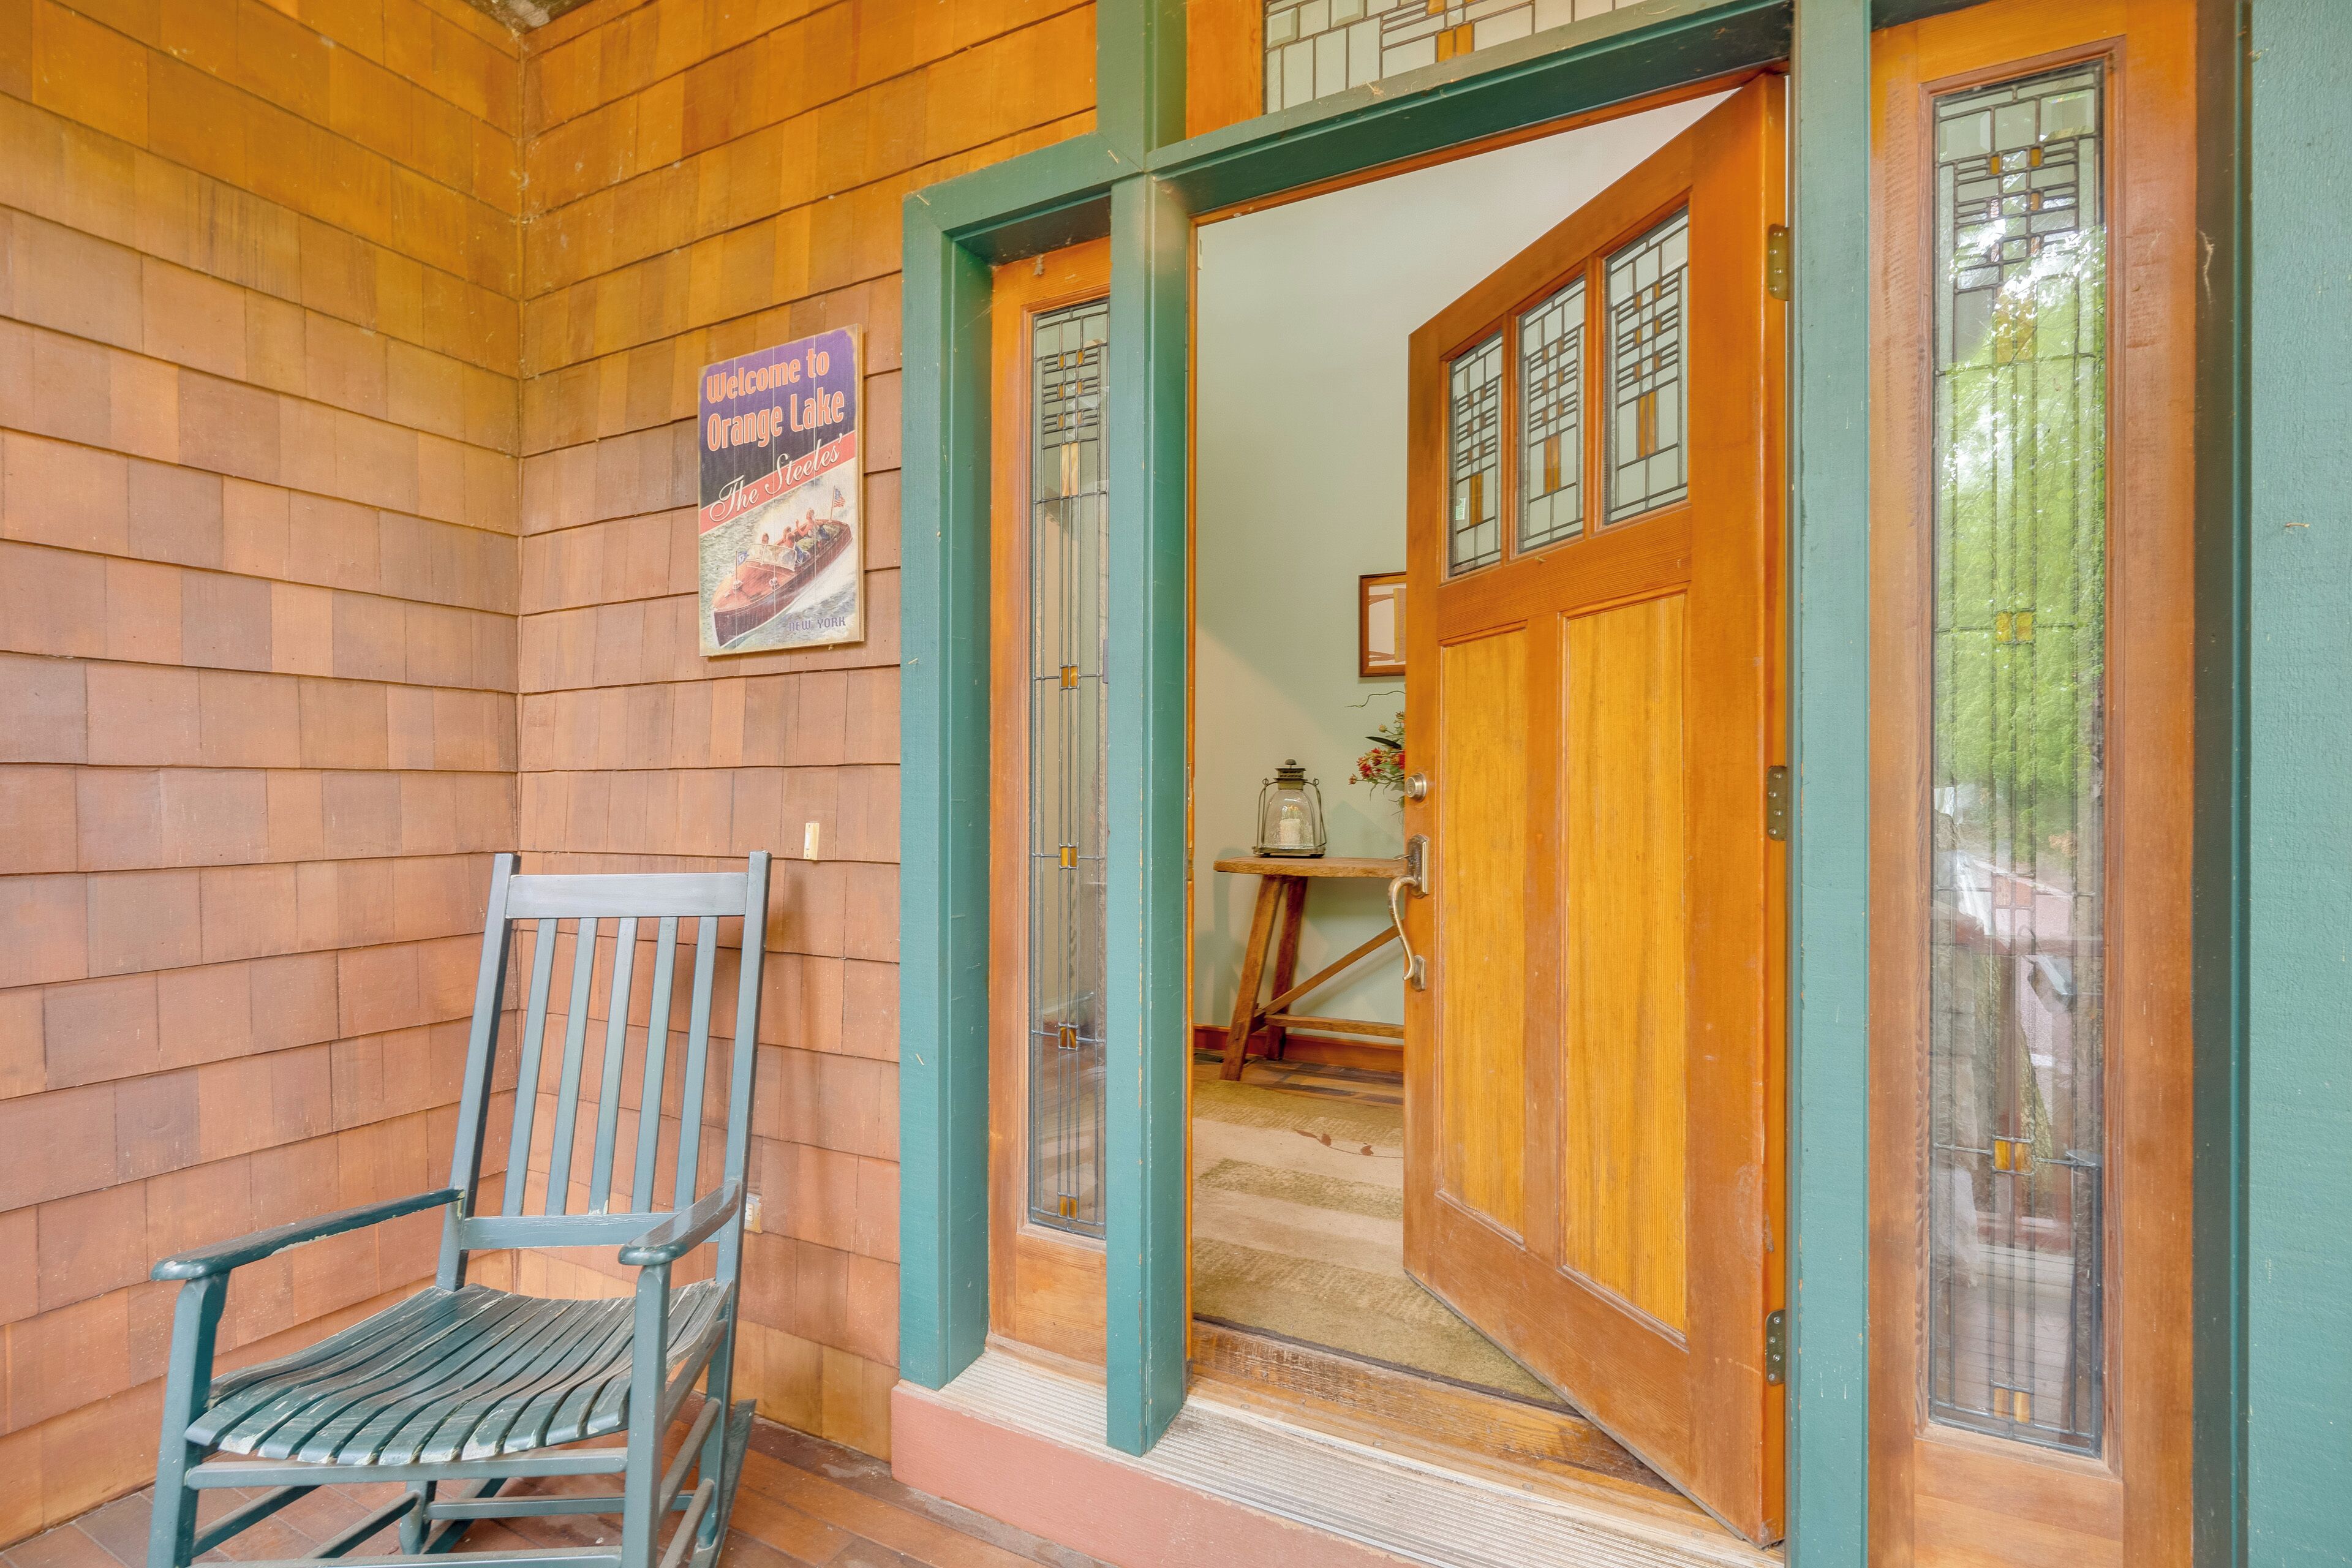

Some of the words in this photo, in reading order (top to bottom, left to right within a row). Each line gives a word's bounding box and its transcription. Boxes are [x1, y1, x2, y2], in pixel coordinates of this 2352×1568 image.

[707, 358, 800, 404] Welcome
[806, 348, 829, 378] to
[707, 406, 783, 451] Orange
[790, 387, 845, 432] Lake
[709, 475, 758, 521] The
[789, 620, 811, 631] NEW
[817, 616, 846, 628] YORK
